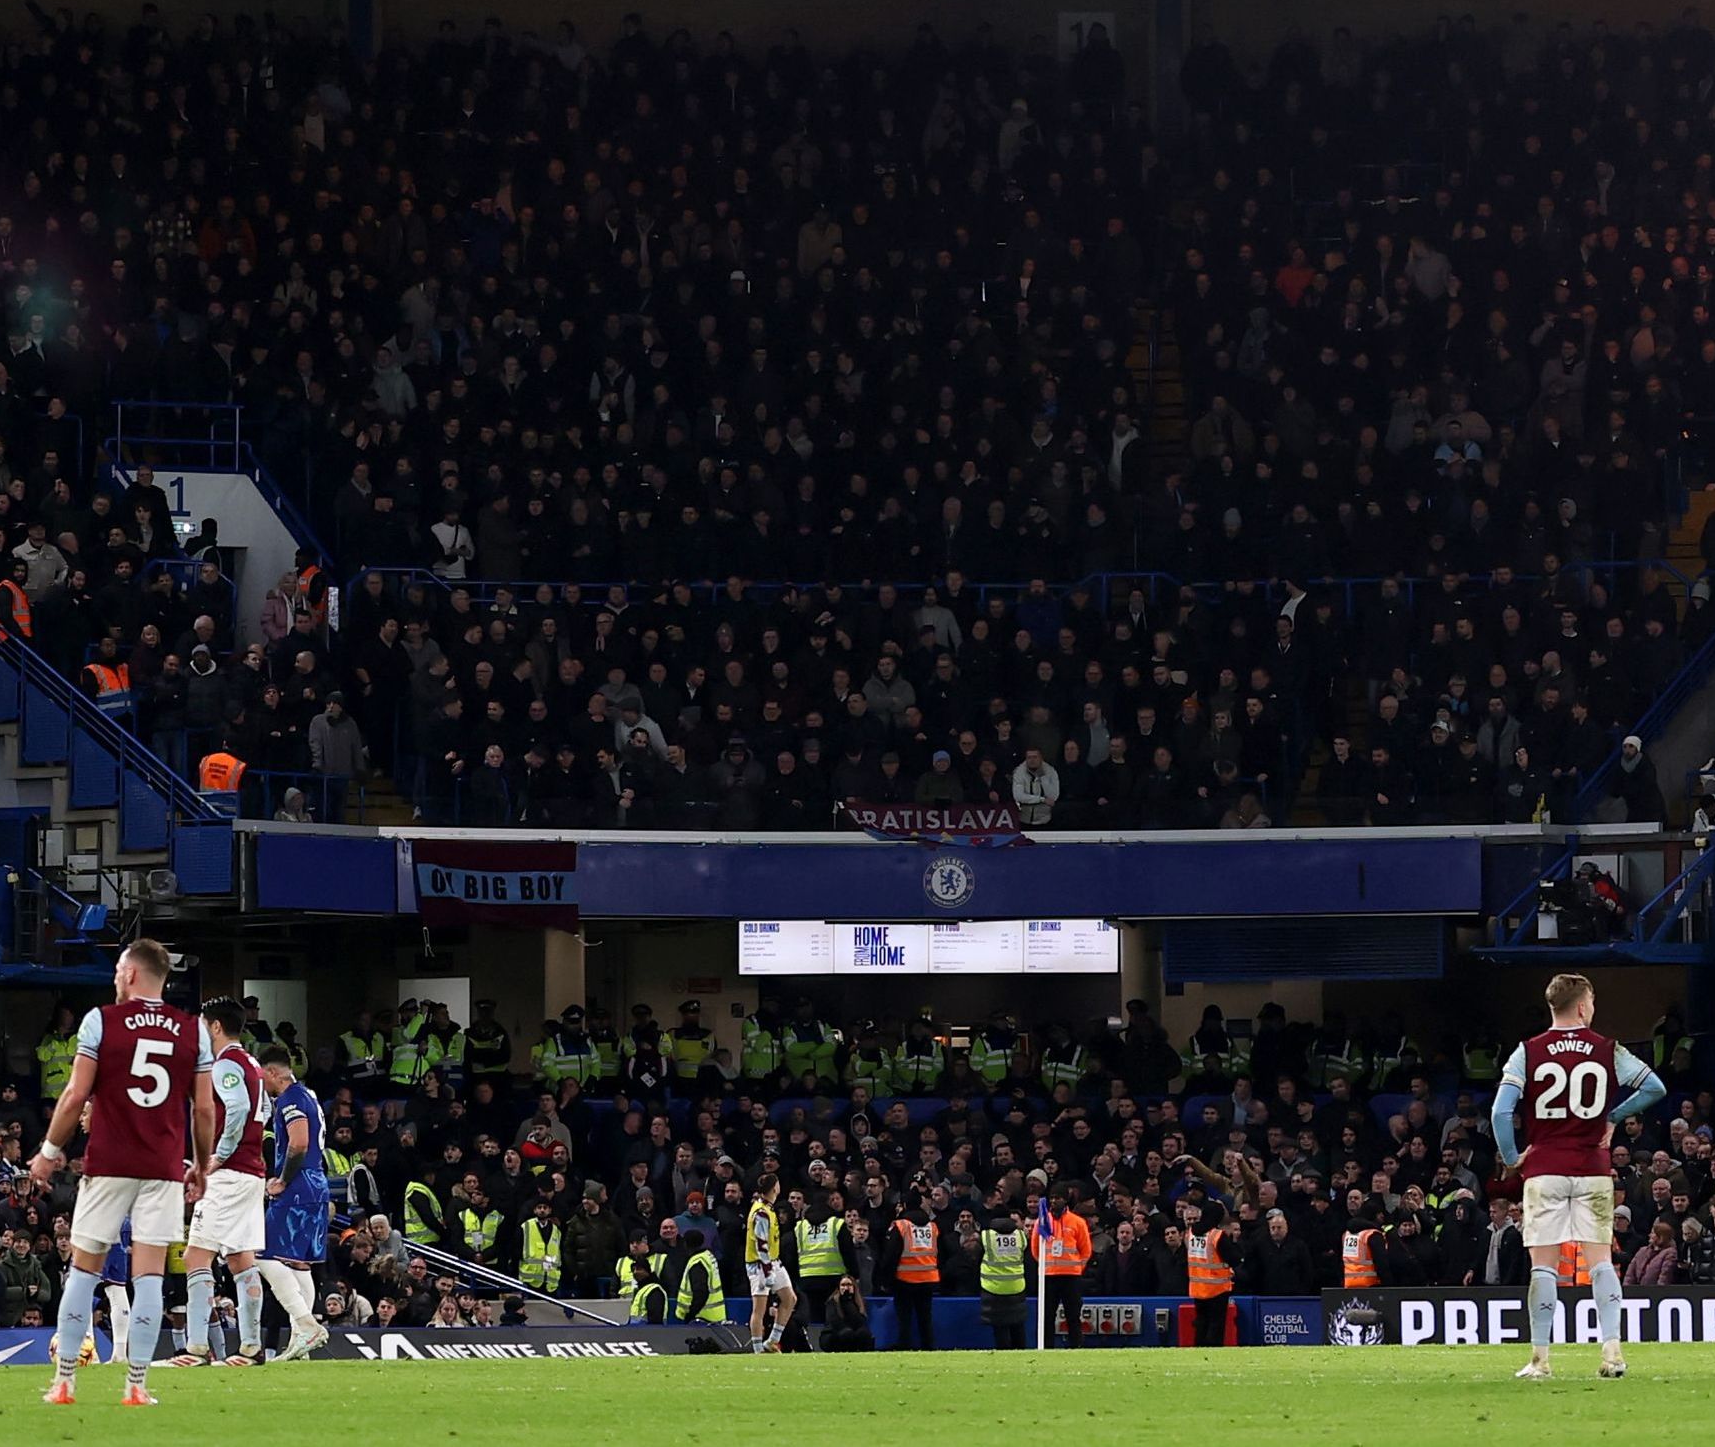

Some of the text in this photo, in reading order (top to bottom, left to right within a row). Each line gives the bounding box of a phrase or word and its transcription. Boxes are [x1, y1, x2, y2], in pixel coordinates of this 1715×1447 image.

[170, 476, 191, 517] 1
[464, 874, 508, 901] BIG
[519, 875, 564, 901] BOY
[744, 923, 758, 933] COLD
[1029, 922, 1061, 931] HOT DRINKS
[854, 927, 889, 946] HOME
[870, 946, 905, 966] HOME
[124, 1013, 182, 1037] COUFAL
[1547, 1040, 1594, 1056] BOWEN
[126, 1038, 174, 1108] 5
[1534, 1061, 1608, 1120] 20
[912, 1229, 932, 1240] 136
[996, 1236, 1016, 1248] 198
[1190, 1237, 1206, 1250] 179
[1345, 1237, 1358, 1248] 128
[1264, 1314, 1303, 1324] CHELSEA
[1264, 1325, 1309, 1334] FOOTBALL
[1264, 1334, 1287, 1343] CLUB
[424, 1343, 541, 1359] INFINITE
[545, 1341, 659, 1357] ATHLETE
